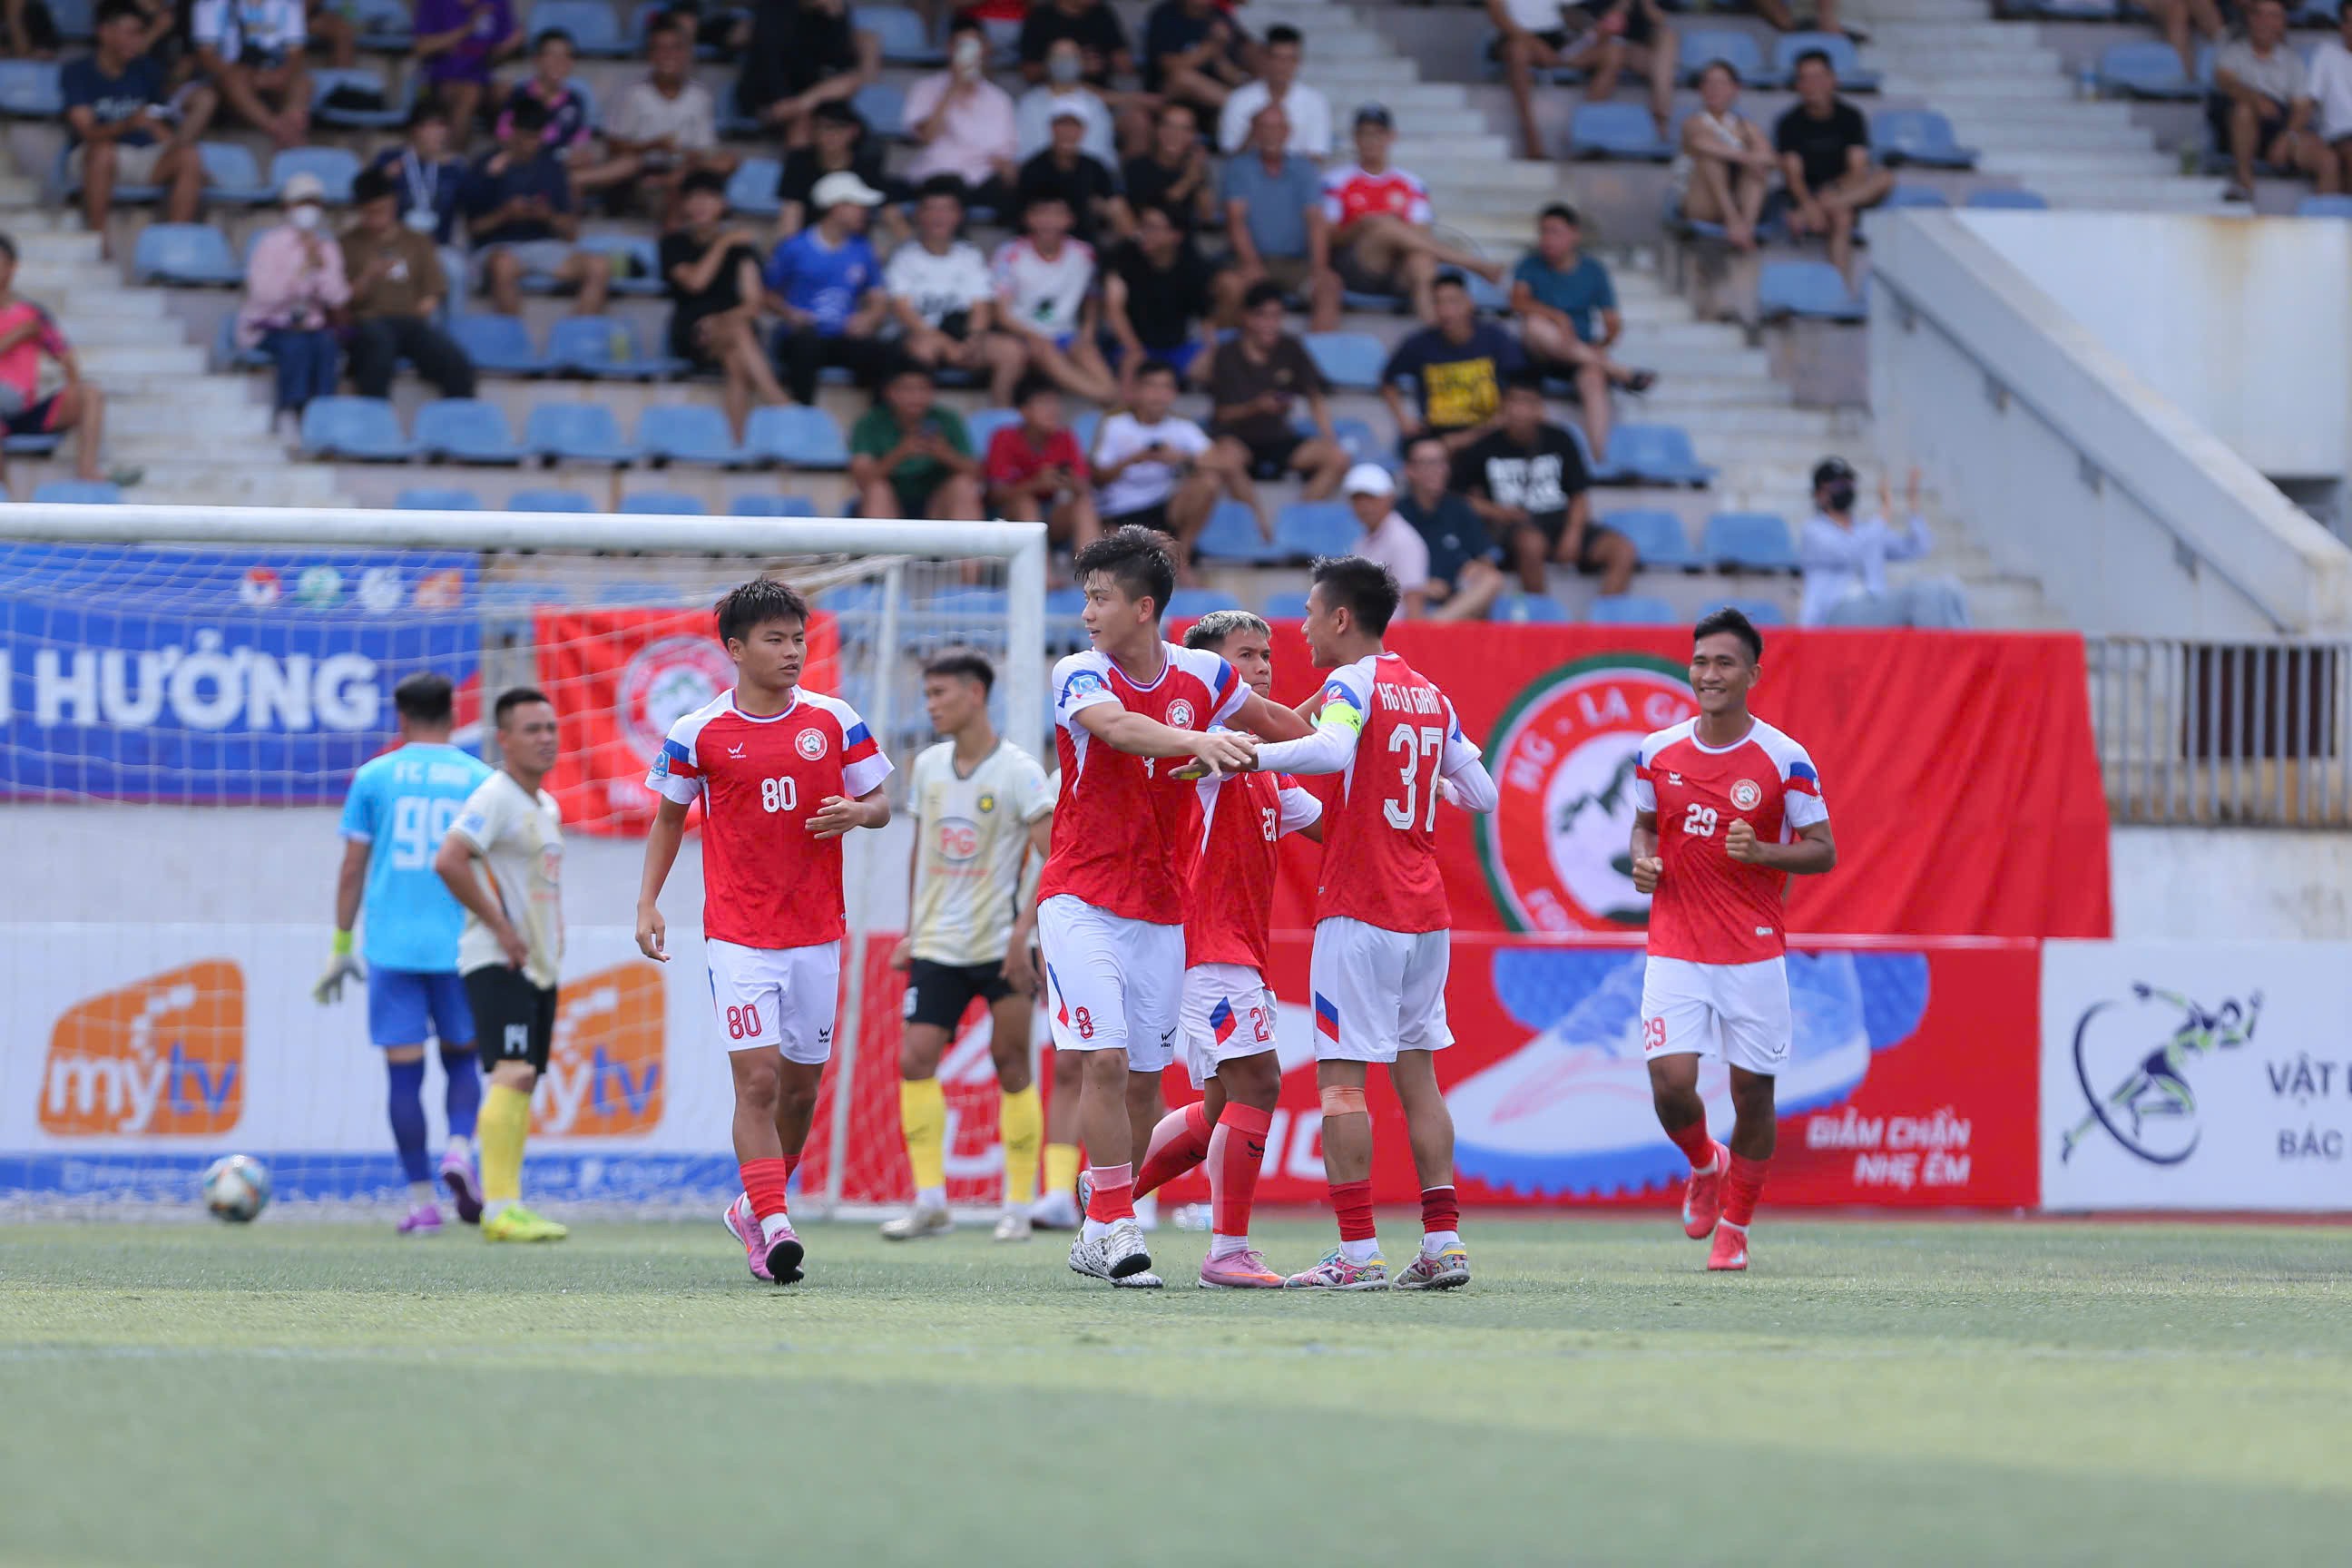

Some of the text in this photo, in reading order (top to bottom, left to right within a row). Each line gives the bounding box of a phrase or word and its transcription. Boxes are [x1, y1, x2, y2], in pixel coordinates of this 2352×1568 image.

[34, 628, 379, 731] HƯỞNG
[1508, 730, 1555, 793] HG
[1577, 686, 1631, 727] LA
[761, 776, 797, 813] 80
[1384, 723, 1444, 832] 37
[1683, 803, 1719, 838] 29
[727, 1004, 762, 1040] 80
[1076, 1006, 1093, 1039] 8
[1642, 1016, 1666, 1051] 29
[49, 1040, 238, 1131] mytv
[2265, 1051, 2338, 1108] VẬT
[2278, 1122, 2344, 1161] BÁC
